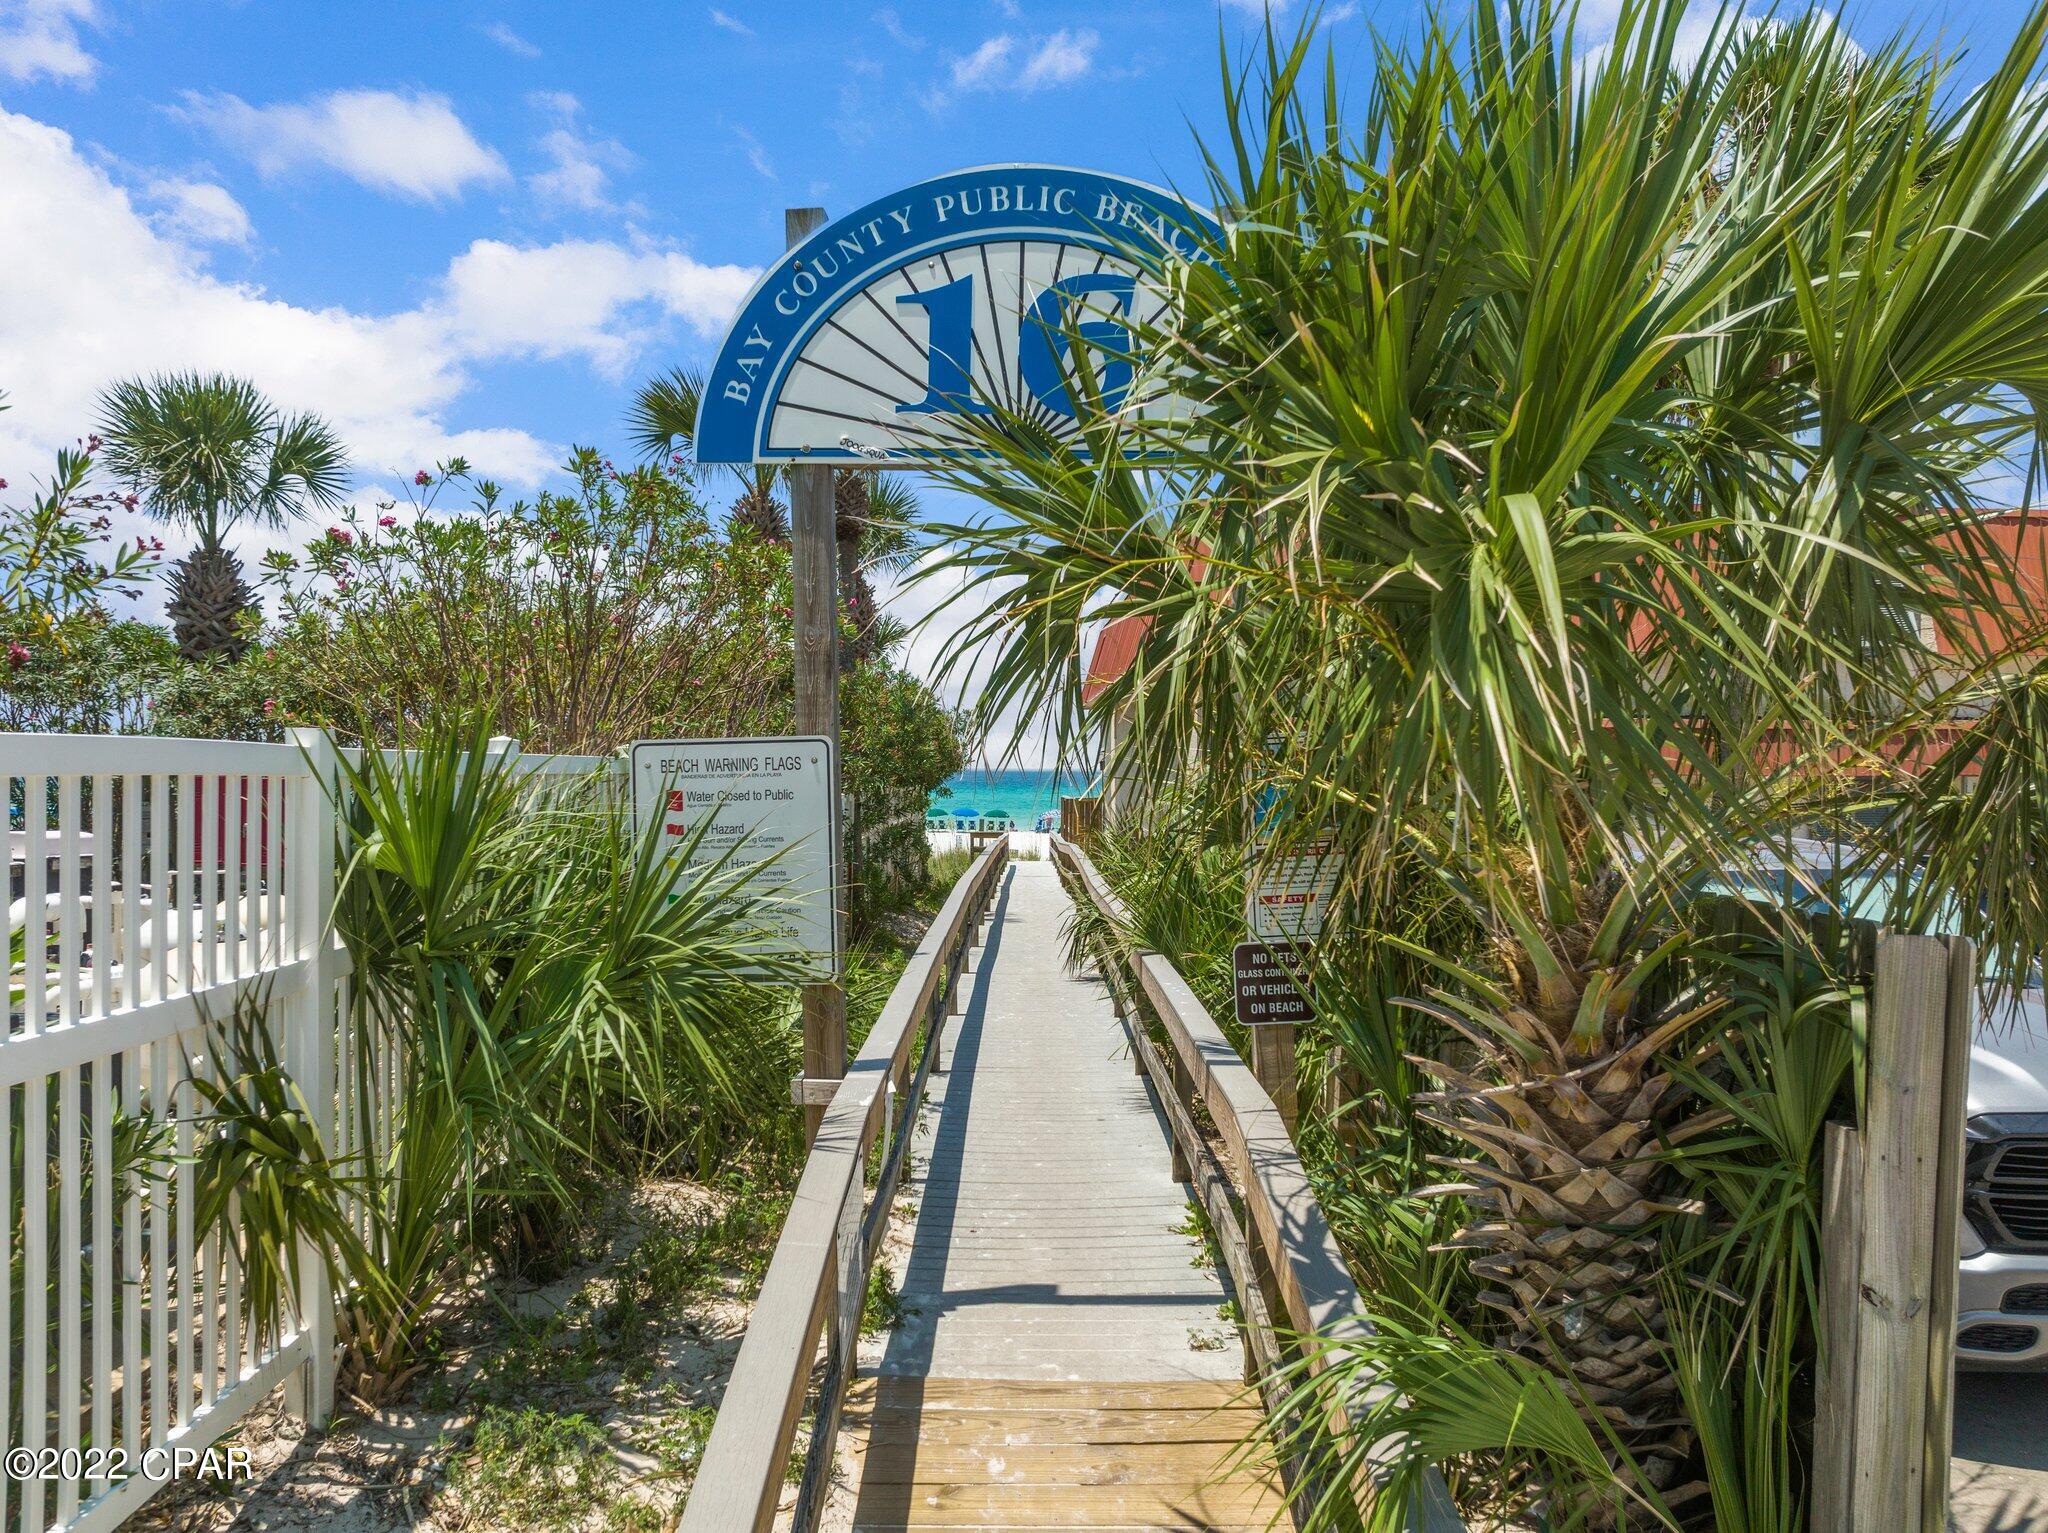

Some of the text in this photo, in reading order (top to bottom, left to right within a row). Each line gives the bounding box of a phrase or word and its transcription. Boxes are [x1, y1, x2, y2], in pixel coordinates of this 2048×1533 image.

[723, 326, 775, 407] BAY
[774, 205, 915, 317] COUNTY
[932, 184, 1079, 223] PUBLIC
[894, 272, 1145, 418] 16
[660, 756, 802, 774] BEACH WARNING FLAGS
[686, 790, 715, 802] Water
[752, 790, 763, 801] to
[764, 788, 794, 801] Public
[711, 823, 745, 835] Hazard
[758, 835, 785, 843] Currents
[758, 869, 787, 877] Currents
[1252, 952, 1297, 964] NO ETS
[1237, 969, 1263, 979] GLASS
[1242, 983, 1310, 997] OR VEHICLS
[1250, 1001, 1304, 1014] ON BEACH
